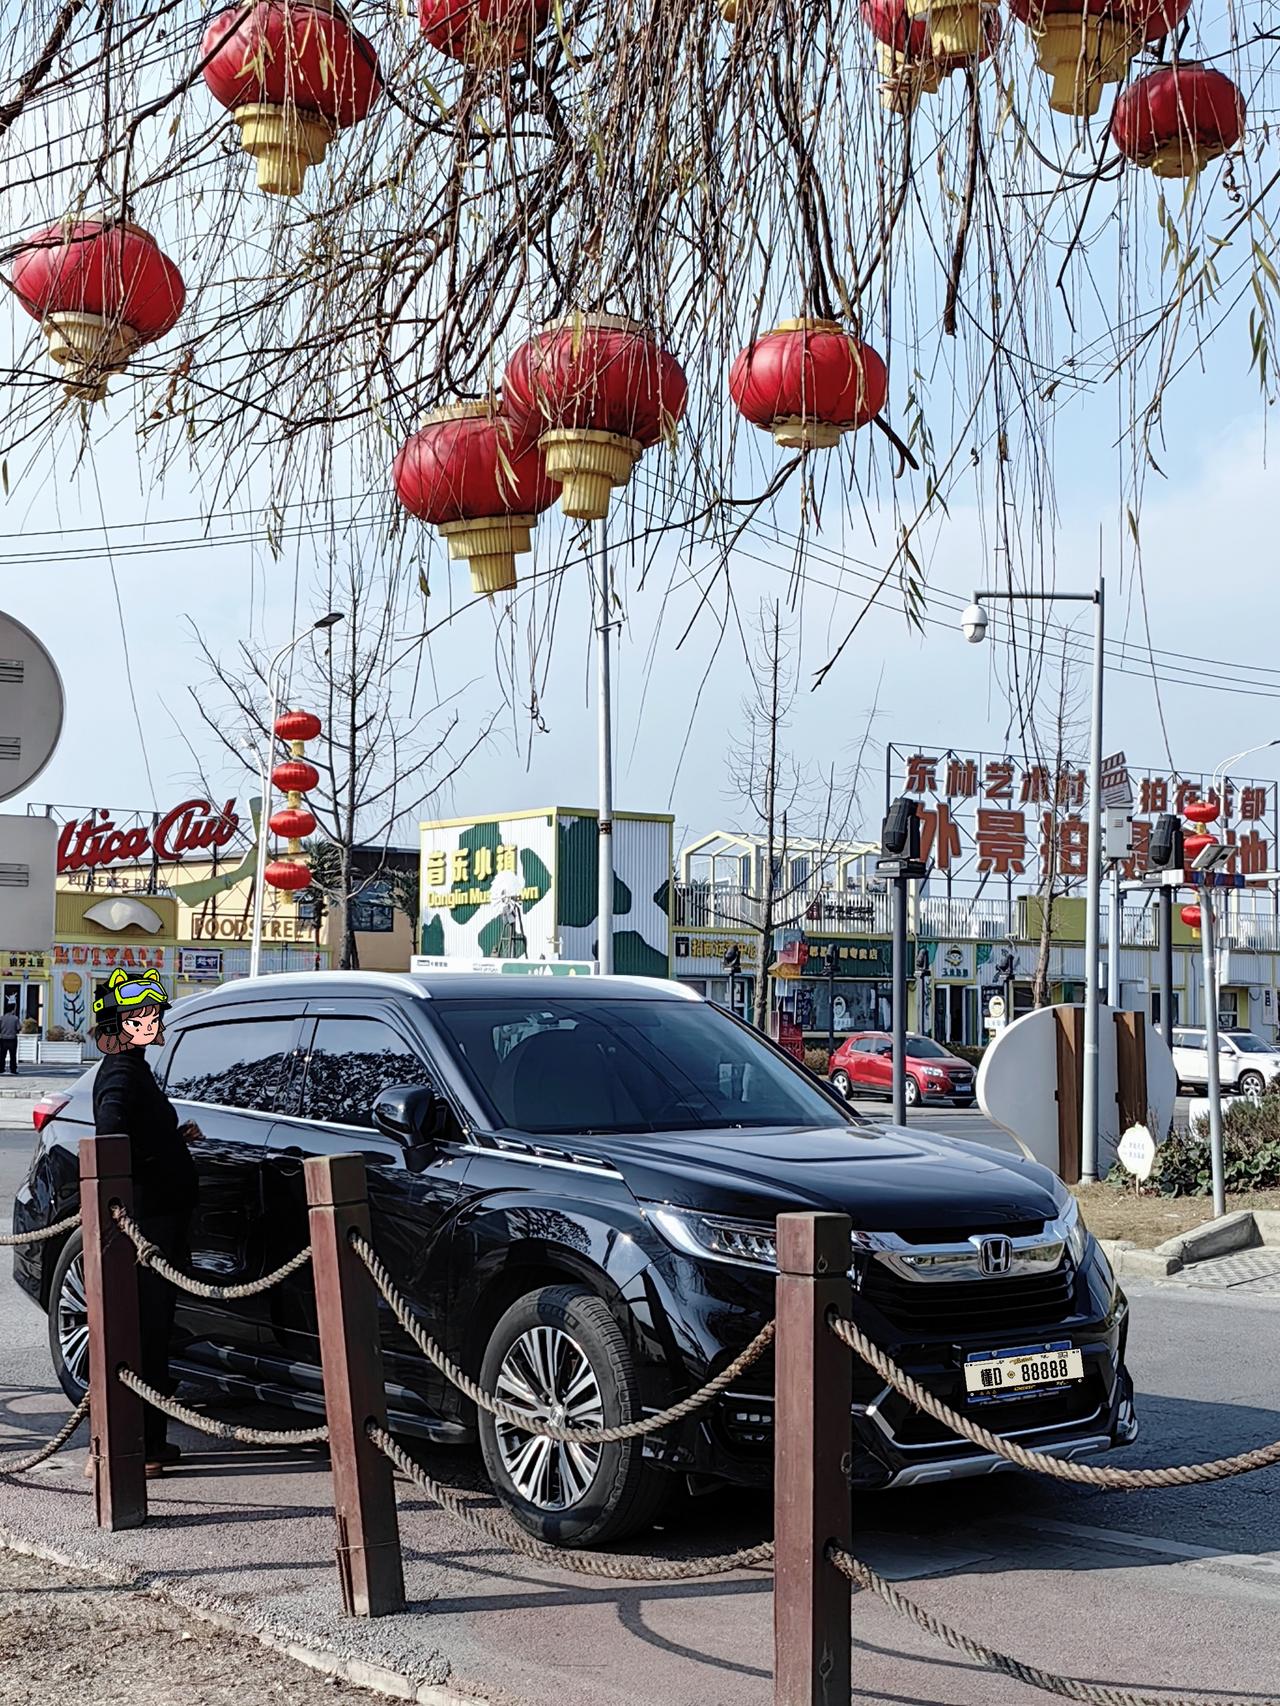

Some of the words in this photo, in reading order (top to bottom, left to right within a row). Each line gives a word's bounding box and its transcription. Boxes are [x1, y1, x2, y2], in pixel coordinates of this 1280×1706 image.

[905, 754, 1087, 806] 东林艺术村
[153, 797, 240, 860] Club
[427, 844, 518, 885] 音乐小镇
[427, 888, 469, 909] Donglin
